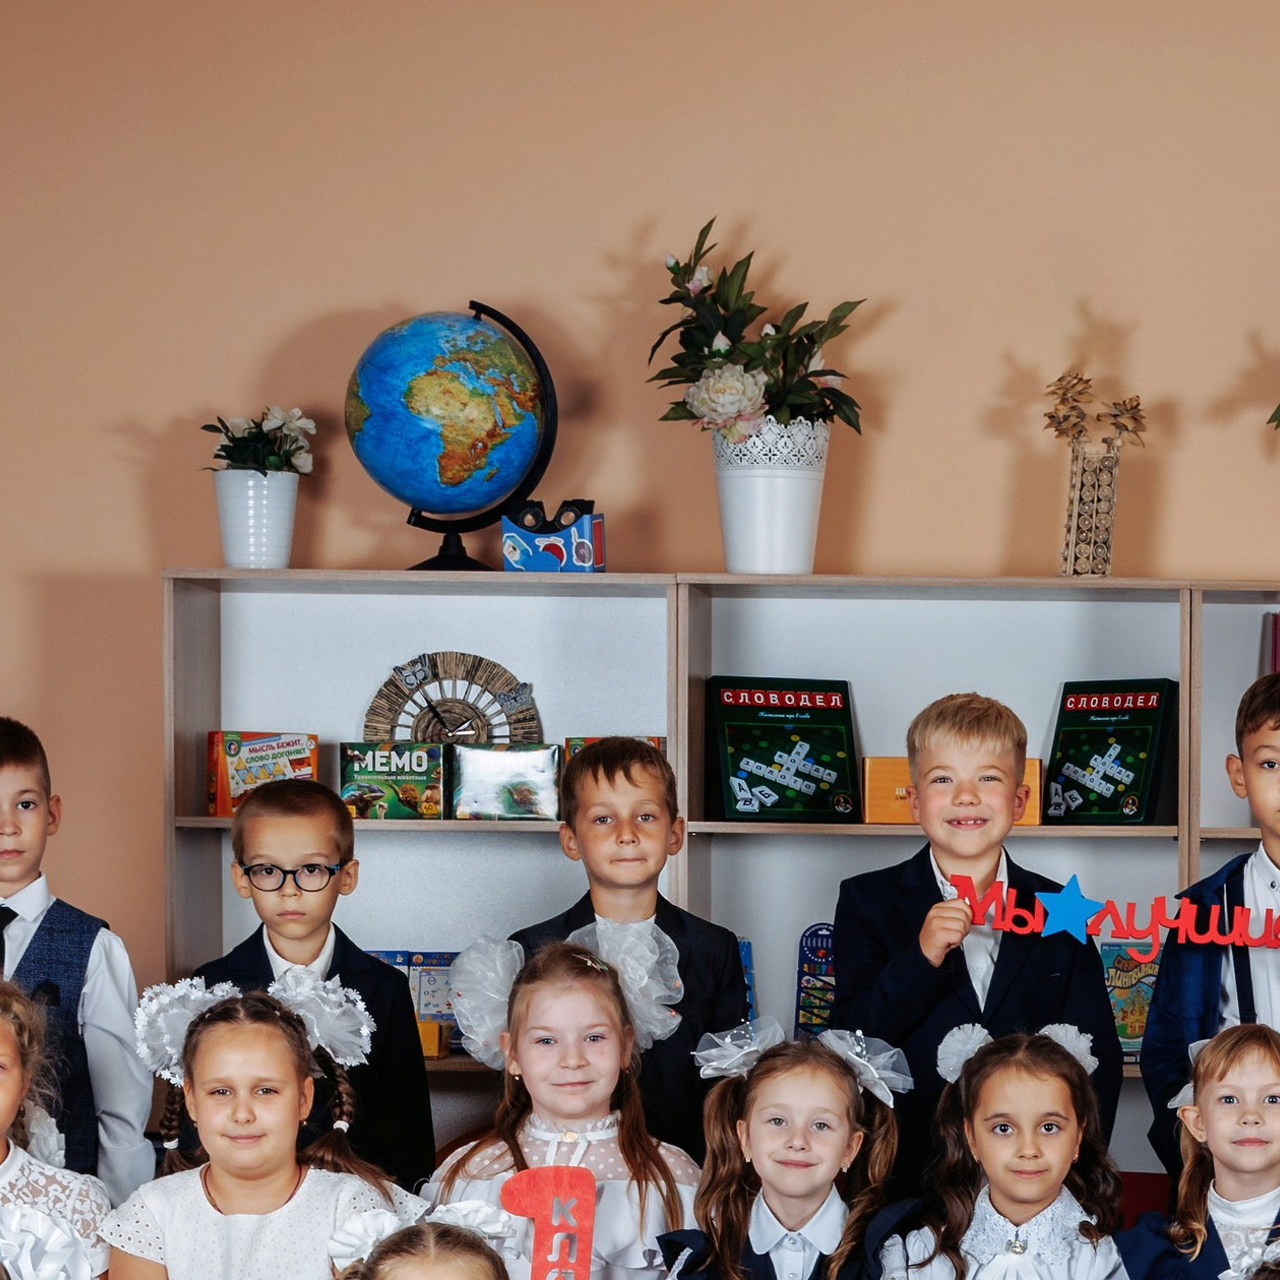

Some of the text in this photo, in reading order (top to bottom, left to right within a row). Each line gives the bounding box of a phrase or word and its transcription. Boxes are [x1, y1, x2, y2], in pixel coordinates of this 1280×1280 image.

[723, 690, 843, 706] СЛОВОДЕЛ
[1067, 696, 1157, 708] СЛОВОДЕЛ
[248, 744, 276, 754] МЫСЛЬ
[276, 739, 304, 750] БЕЖИТ,
[245, 747, 306, 764] СЛОВО ДОГОНЯЕТ
[353, 750, 428, 772] МЕМО
[950, 874, 1045, 933] Мы
